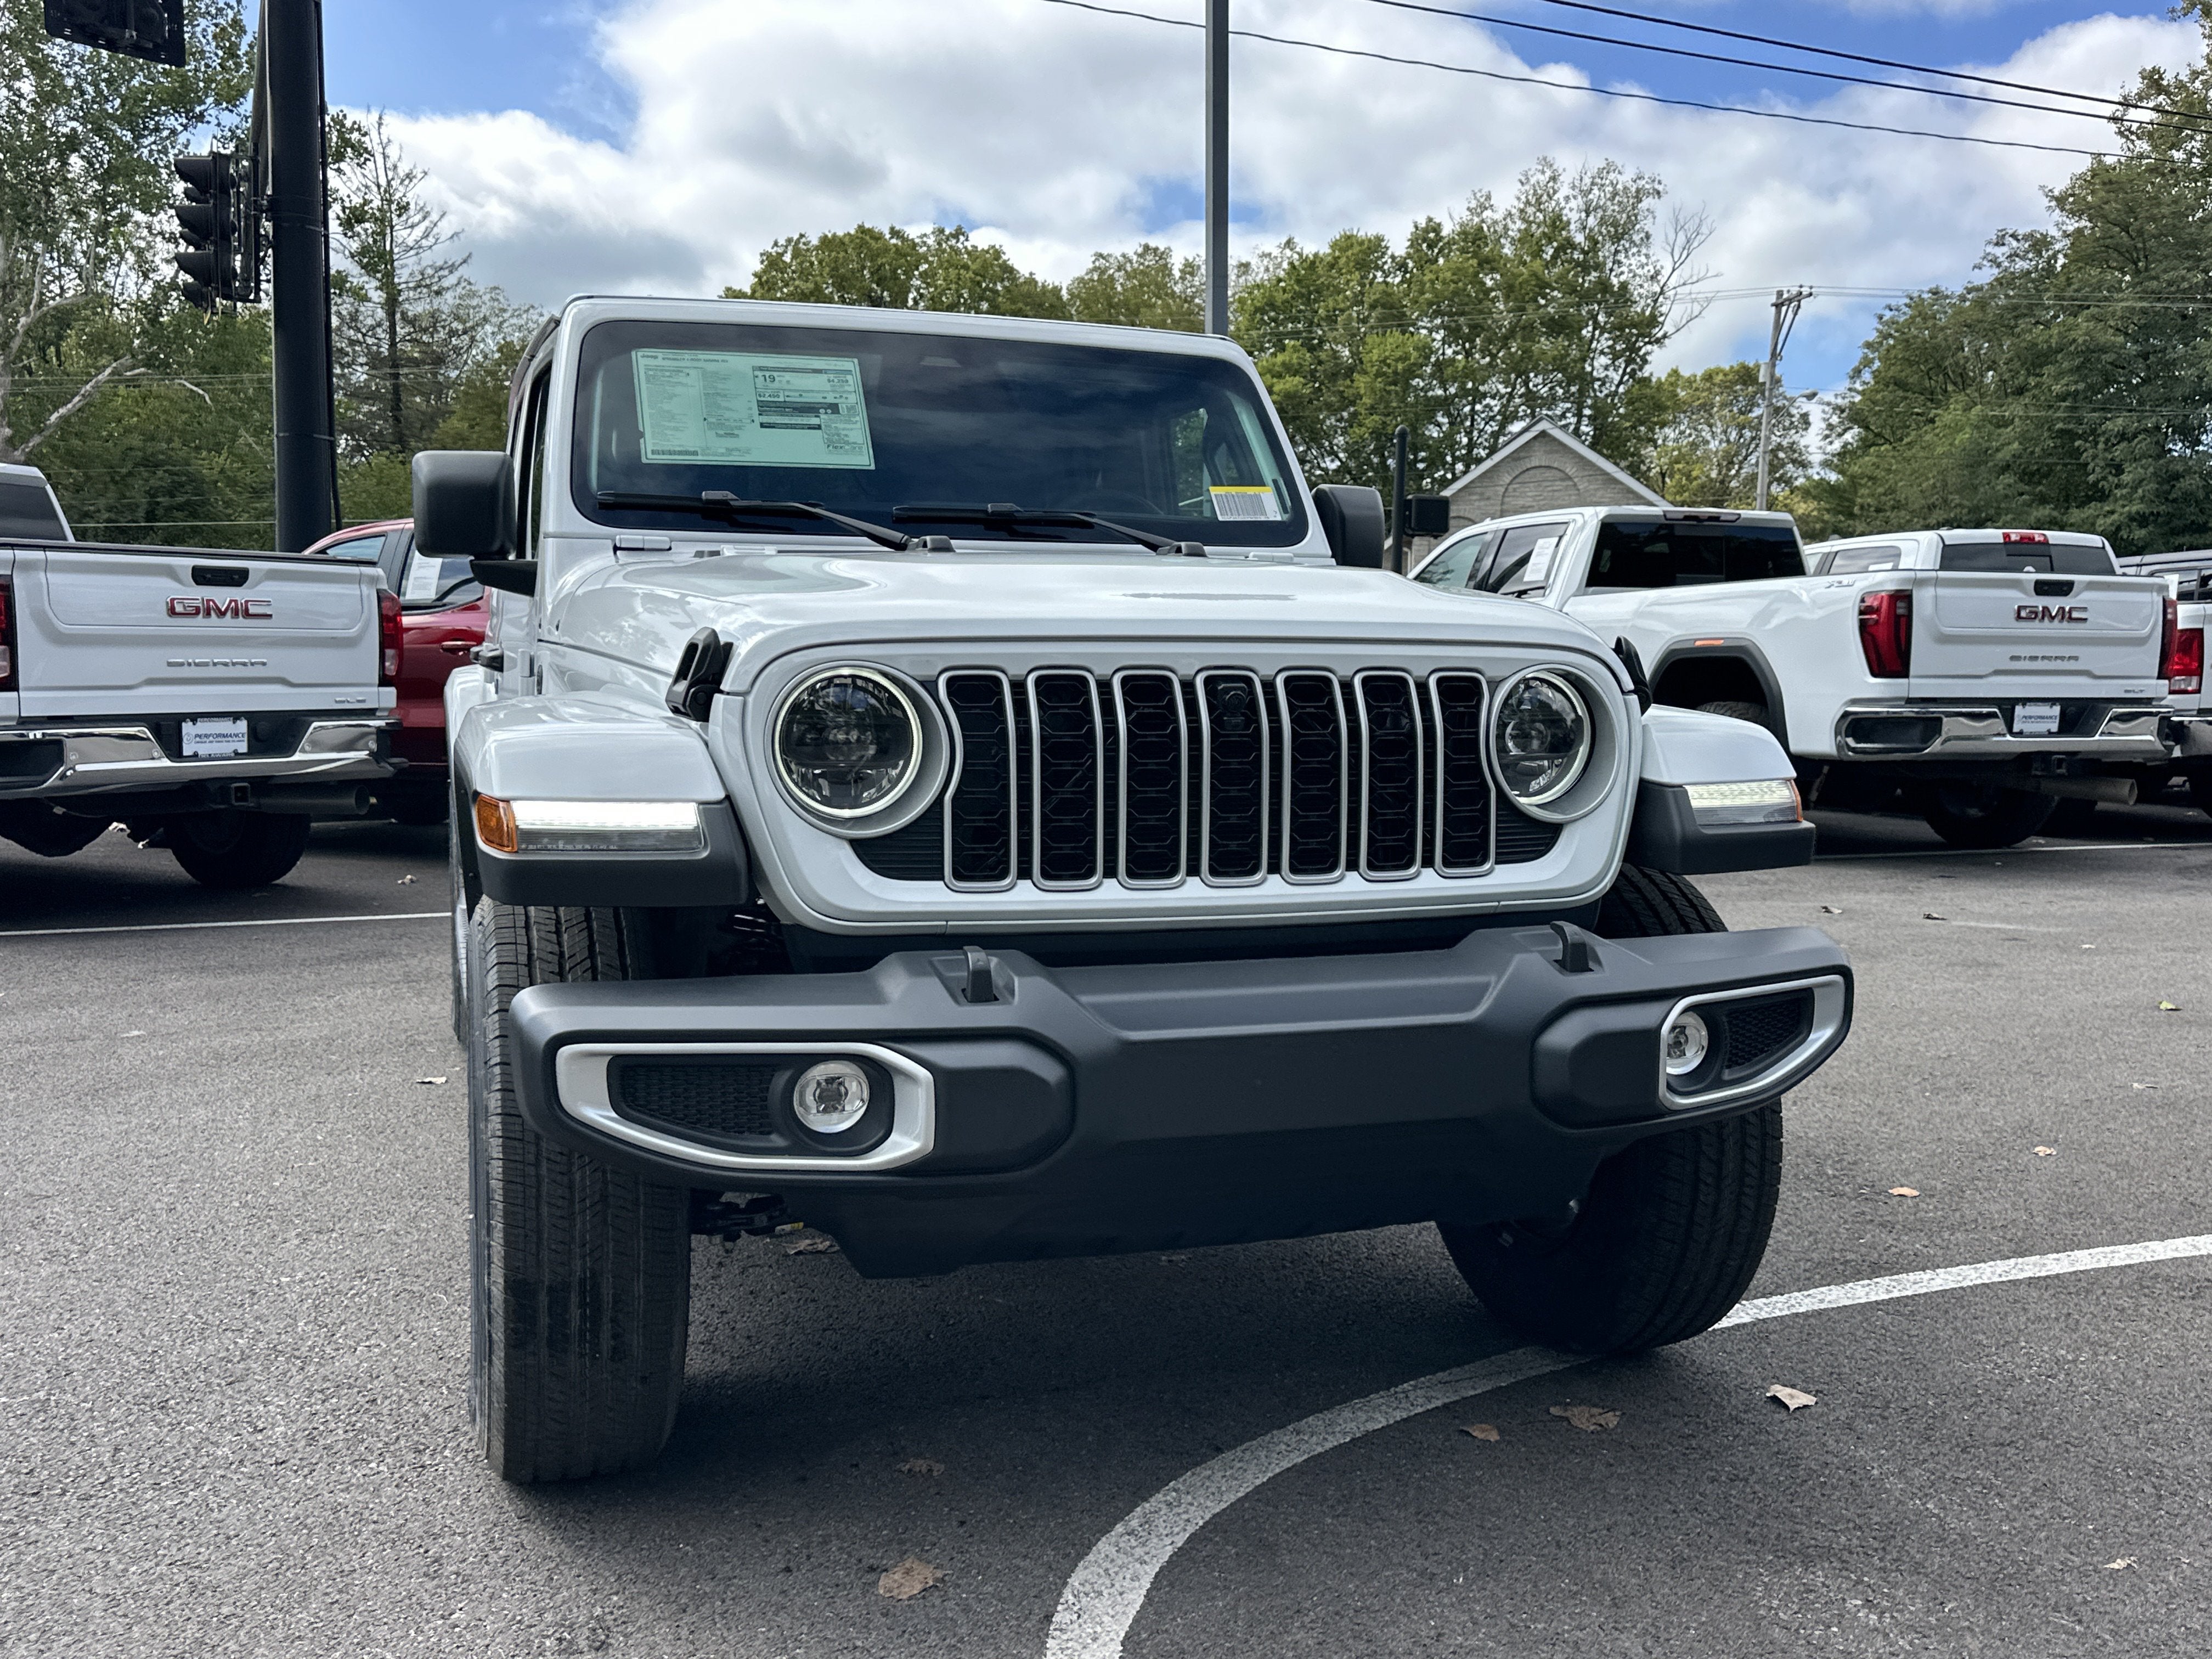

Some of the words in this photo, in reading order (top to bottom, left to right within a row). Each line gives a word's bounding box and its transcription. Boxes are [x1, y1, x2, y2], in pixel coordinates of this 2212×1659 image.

[761, 374, 775, 382] 19
[166, 596, 273, 619] GMC
[2015, 605, 2088, 623] GMC
